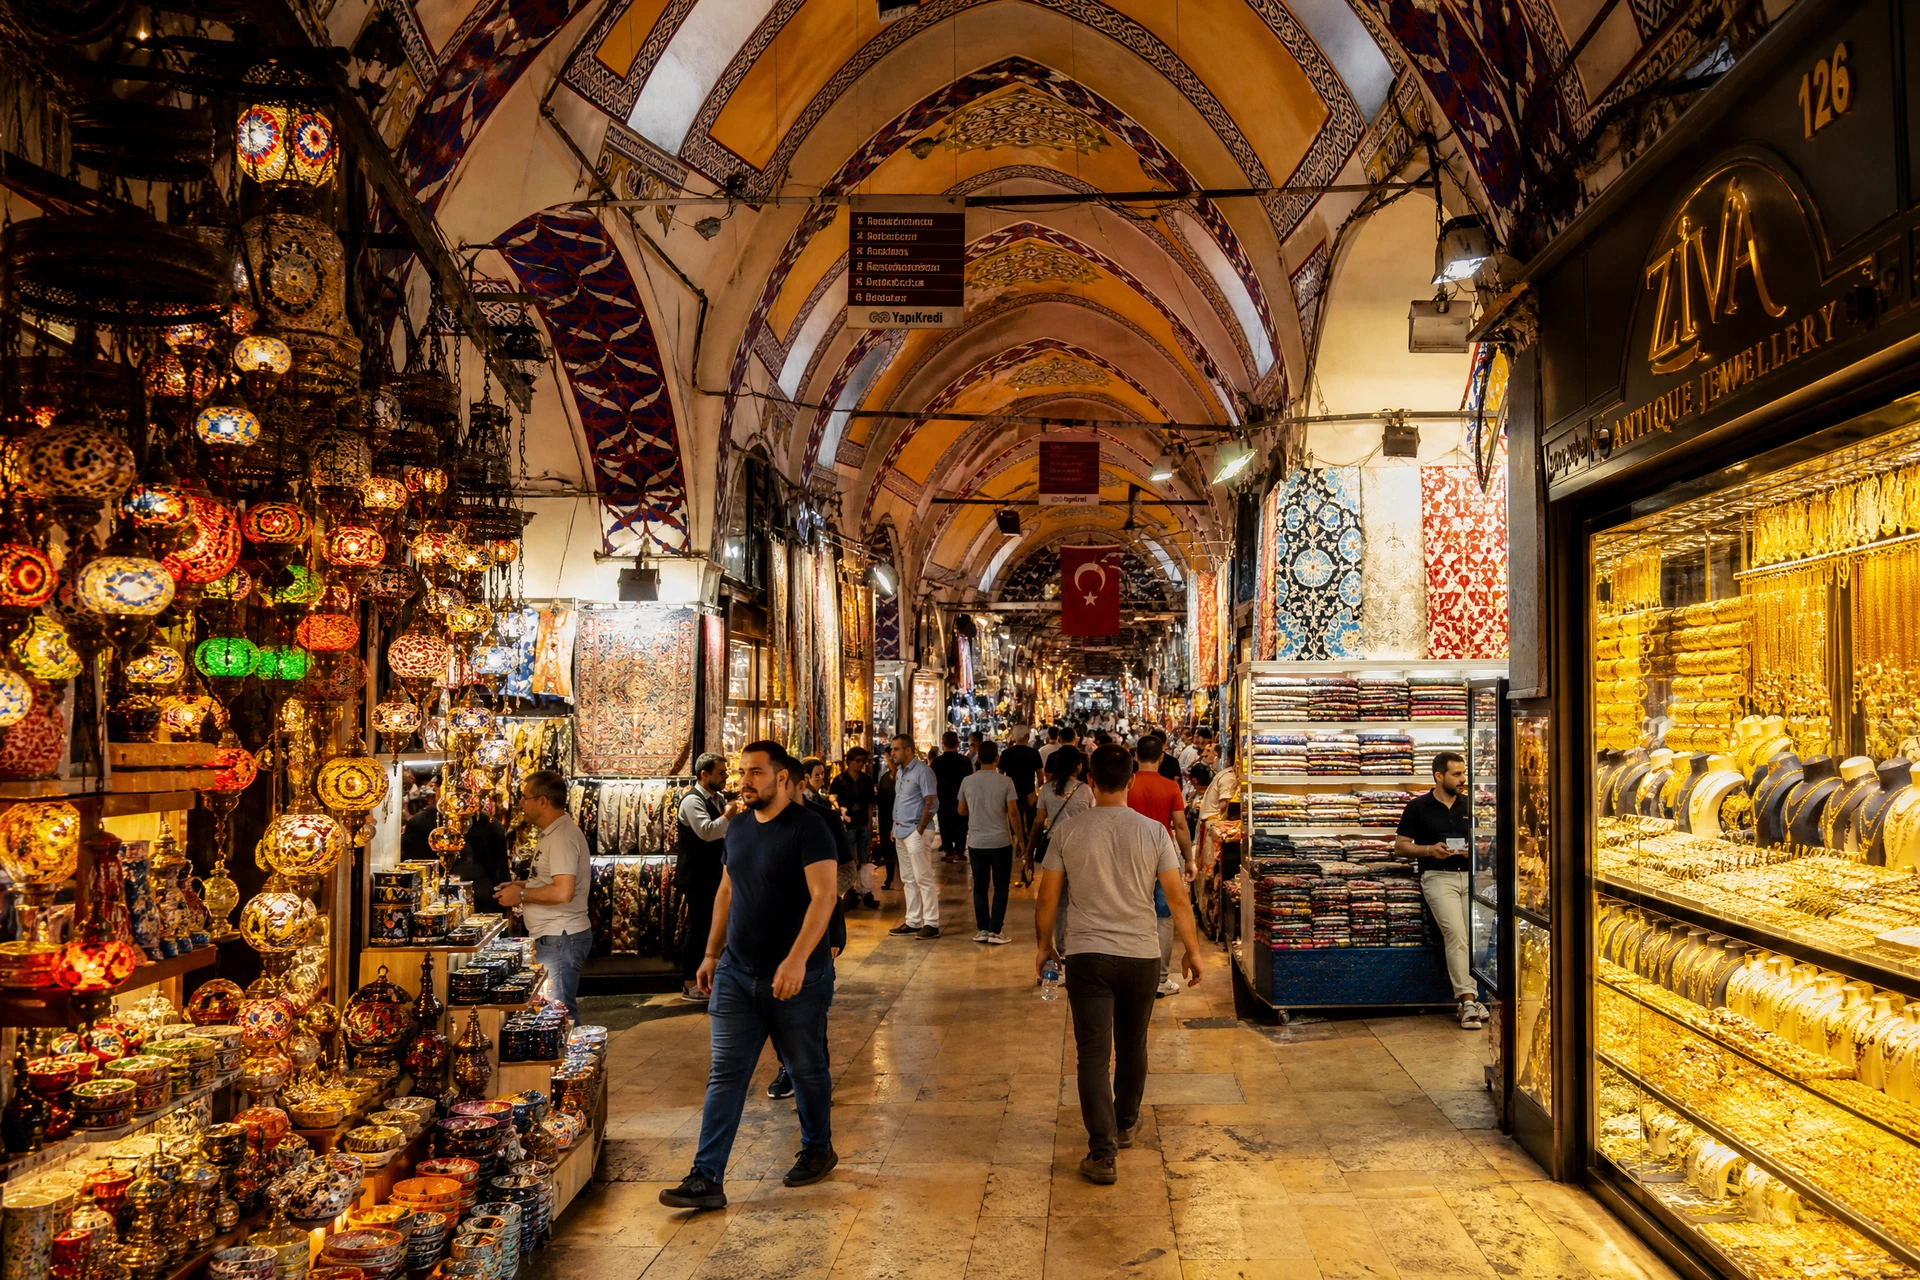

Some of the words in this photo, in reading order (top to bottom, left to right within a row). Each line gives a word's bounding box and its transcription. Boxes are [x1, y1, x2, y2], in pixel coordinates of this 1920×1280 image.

[1799, 42, 1851, 140] 126
[1612, 381, 1695, 450] ANTIQUE
[1700, 300, 1837, 415] JEWELLERY
